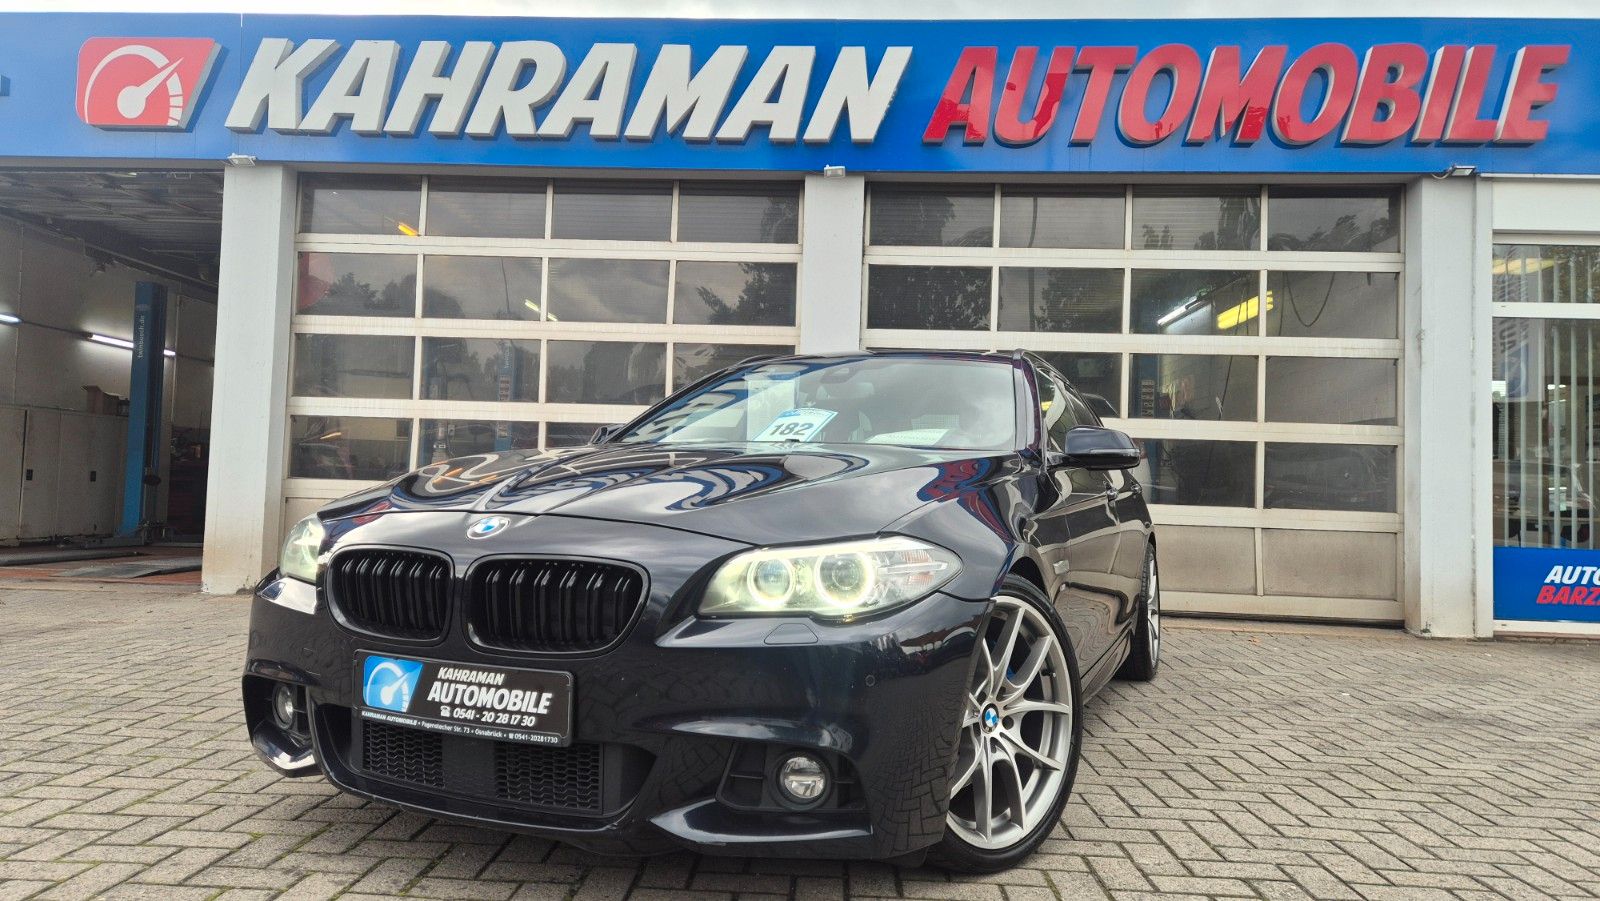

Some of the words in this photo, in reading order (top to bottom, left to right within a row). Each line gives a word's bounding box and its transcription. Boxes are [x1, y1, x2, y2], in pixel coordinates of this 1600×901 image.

[224, 37, 913, 142] KAHRAMAN
[921, 43, 1572, 146] AUTOMOBILE
[770, 422, 814, 436] 182
[1536, 585, 1600, 606] BARZ
[437, 667, 505, 686] KAHRAMAN
[427, 681, 552, 714] AUTOMOBILE
[361, 710, 386, 720] KAHRAMAN
[386, 715, 418, 726] AUTOMOBILE
[453, 708, 475, 720] 0541
[481, 711, 495, 723] 20
[495, 713, 510, 725] 28
[510, 715, 521, 725] 17
[520, 715, 536, 727] 30
